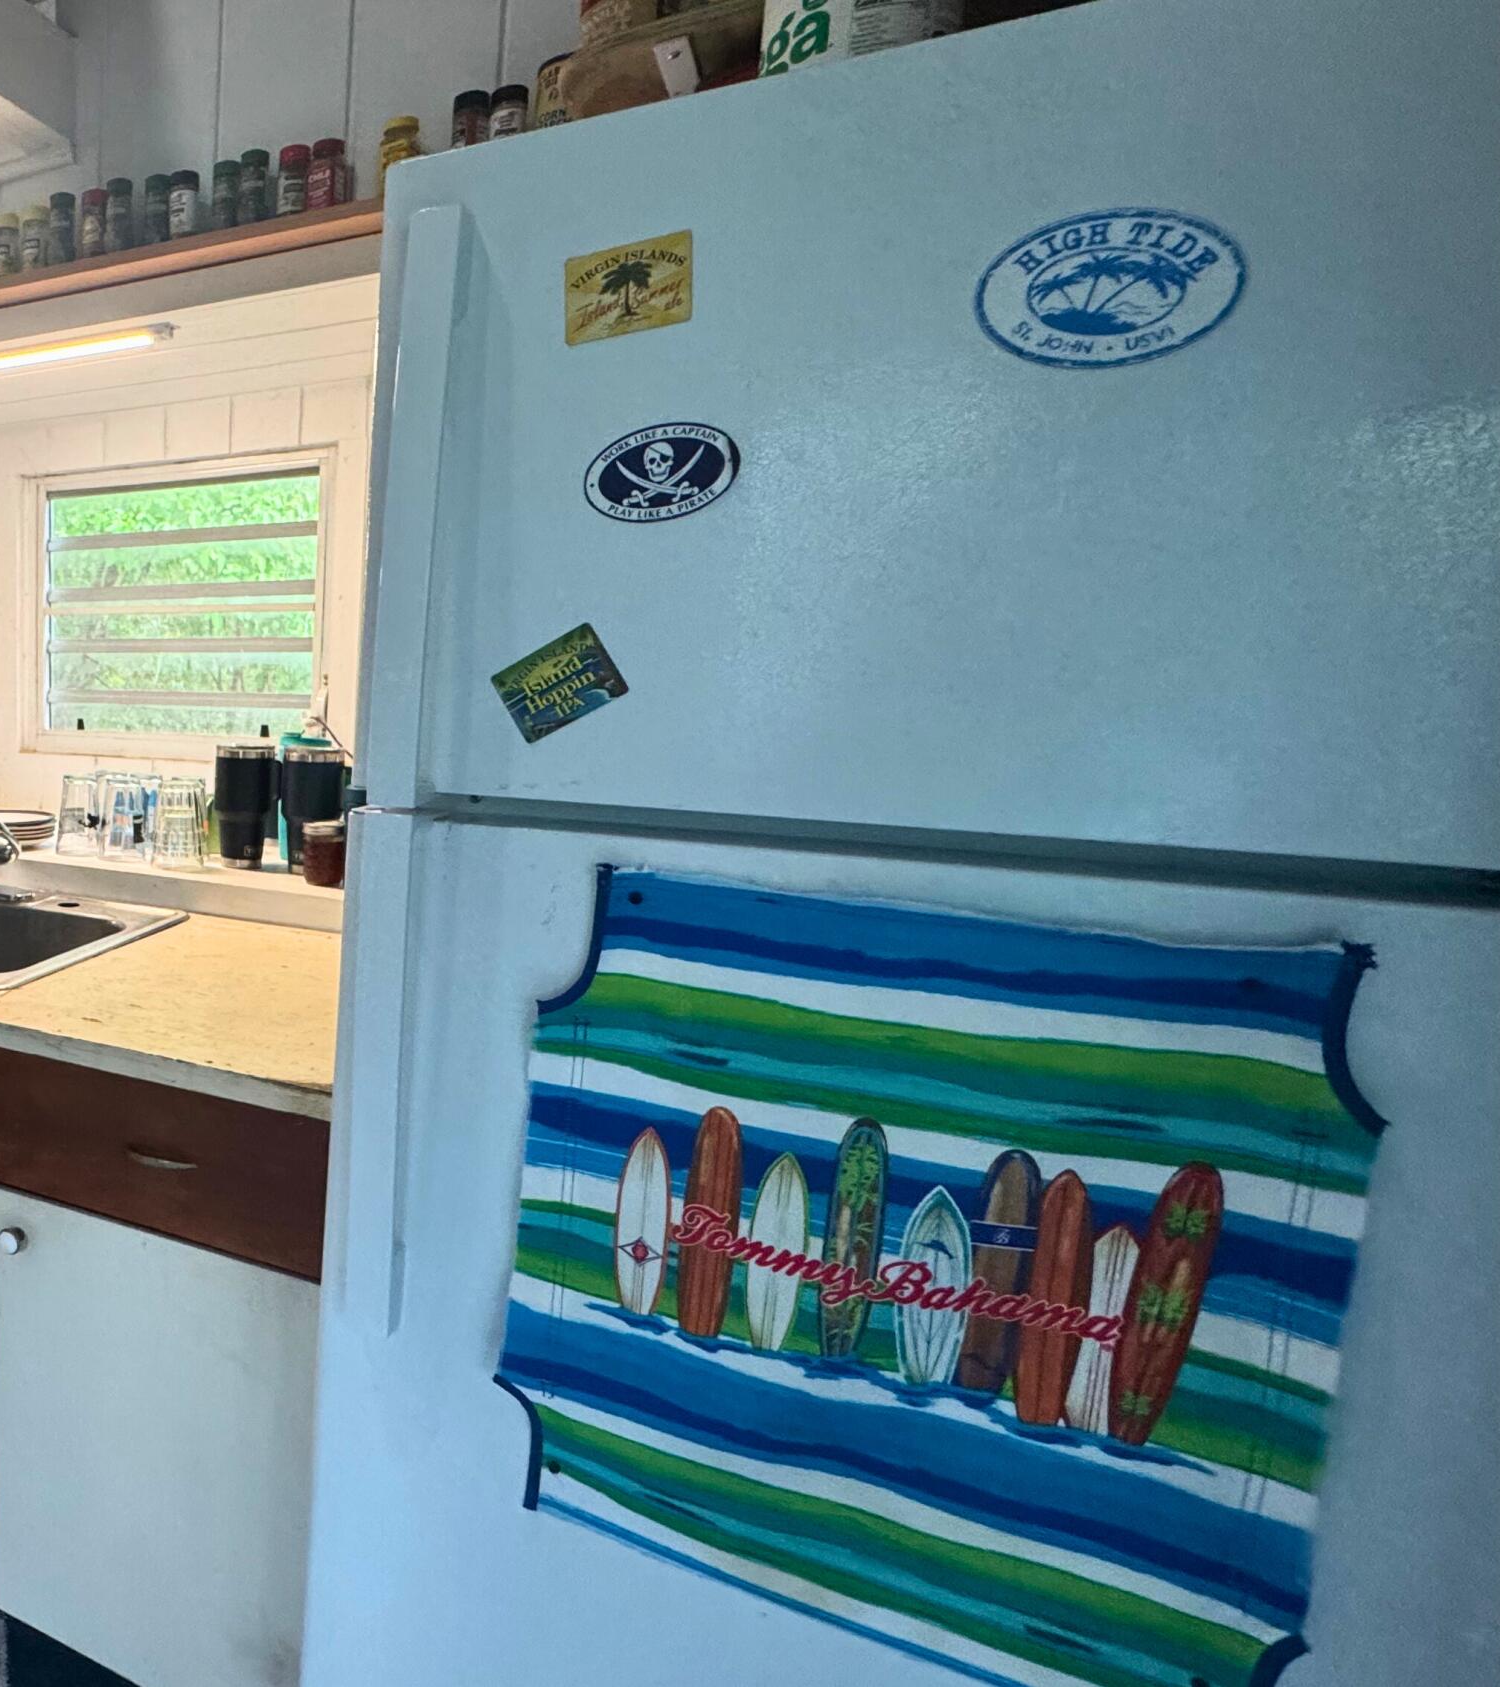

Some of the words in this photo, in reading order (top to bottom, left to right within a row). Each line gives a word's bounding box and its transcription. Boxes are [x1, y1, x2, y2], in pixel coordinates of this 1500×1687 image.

[1011, 221, 1112, 276] HIGH
[1126, 220, 1221, 275] TIDE
[570, 255, 620, 290] VIRGIN
[624, 250, 686, 267] ISLANDS
[1037, 339, 1094, 355] JOHN
[1125, 326, 1176, 351] USVI
[600, 440, 632, 463] WORK
[634, 431, 657, 443] LIKE
[660, 429, 669, 437] A
[672, 426, 720, 443] CAPTAIN
[607, 504, 634, 518] PLAY
[637, 508, 660, 519] LIKE
[665, 507, 674, 515] A
[677, 489, 718, 513] PIRATE
[523, 656, 583, 698] Island
[524, 671, 597, 715] Hoppin
[555, 696, 586, 718] IPA
[671, 1202, 870, 1306] Tommy
[871, 1258, 1124, 1344] Bahama
